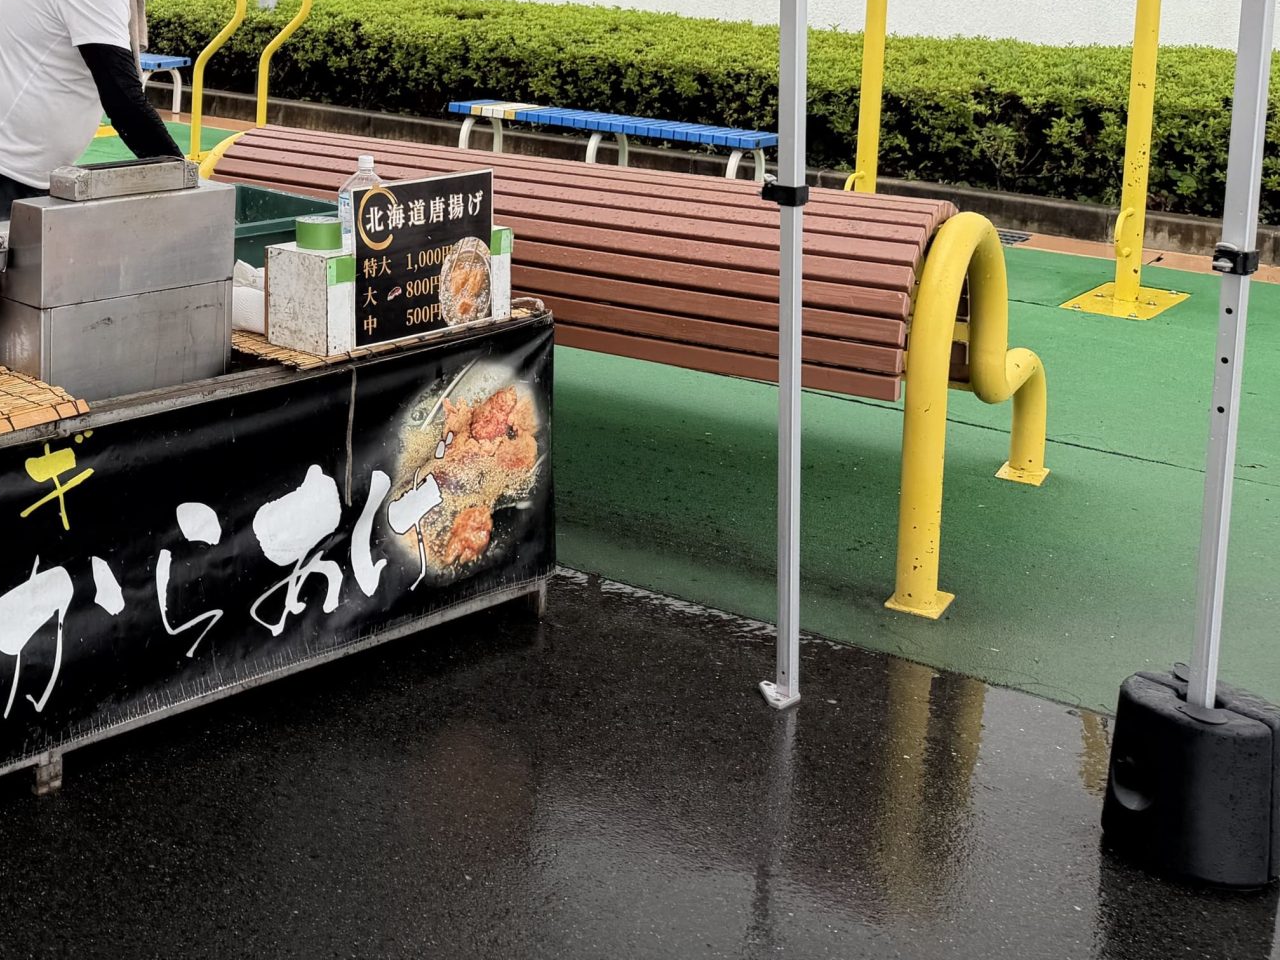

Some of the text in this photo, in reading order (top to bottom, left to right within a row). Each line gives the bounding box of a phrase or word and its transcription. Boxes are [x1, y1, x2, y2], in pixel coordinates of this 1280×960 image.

[365, 190, 484, 234] 北海道唐揚げ
[363, 244, 454, 279] 特大 1,000円
[362, 274, 442, 308] 大 800円
[363, 303, 442, 337] 中 500円
